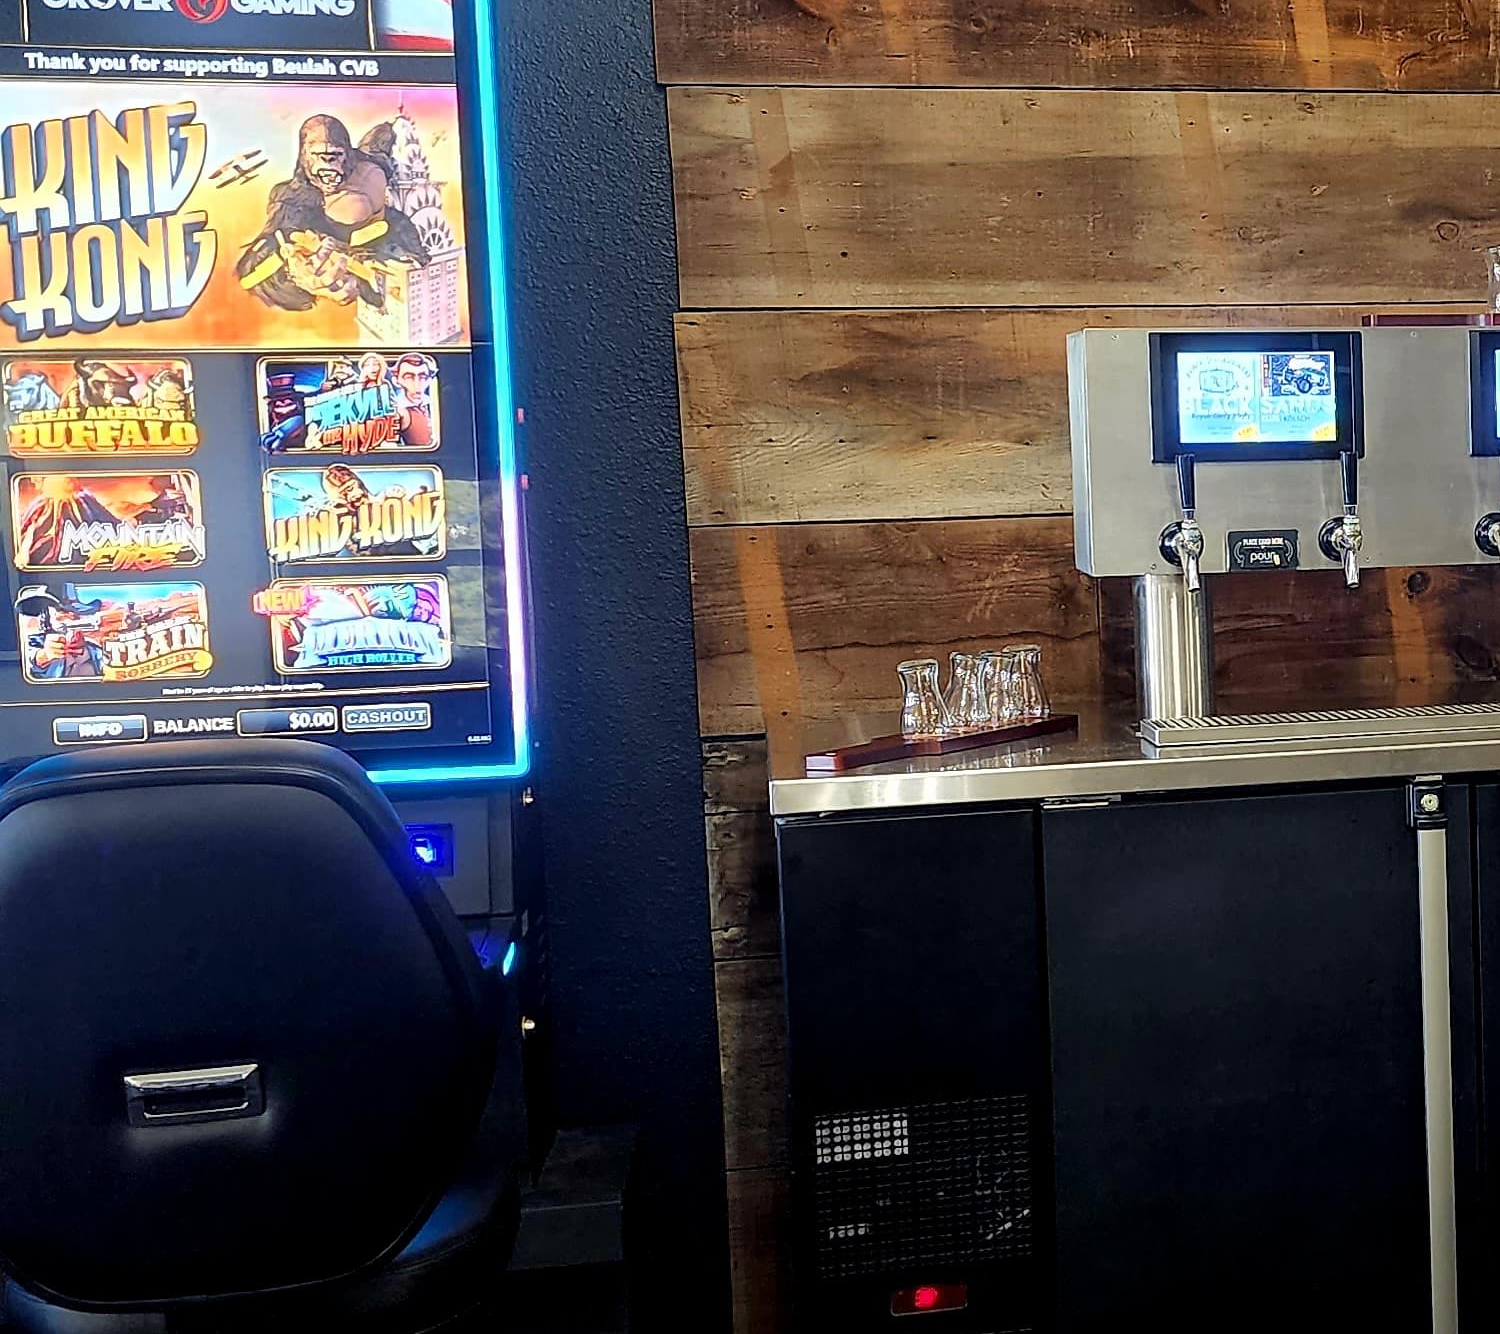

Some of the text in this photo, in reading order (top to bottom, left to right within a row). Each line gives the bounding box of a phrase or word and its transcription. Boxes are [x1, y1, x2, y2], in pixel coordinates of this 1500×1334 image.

[24, 52, 86, 72] Thank
[89, 58, 126, 75] you
[129, 54, 160, 72] for
[162, 57, 269, 78] supporting
[338, 59, 380, 77] CVB
[0, 101, 208, 235] KING
[2, 210, 218, 341] KONG
[18, 405, 186, 422] GREAT AMERICAN
[8, 420, 200, 450] BUFFALO
[341, 414, 401, 455] HYDE
[59, 519, 207, 562] MOUNTAIN
[268, 489, 446, 565] KING KONG
[82, 543, 183, 572] FIRE
[104, 622, 207, 668] TRAIN
[153, 717, 235, 735] BALANCE
[288, 711, 335, 730] $0.00
[345, 708, 427, 725] CASHOUT
